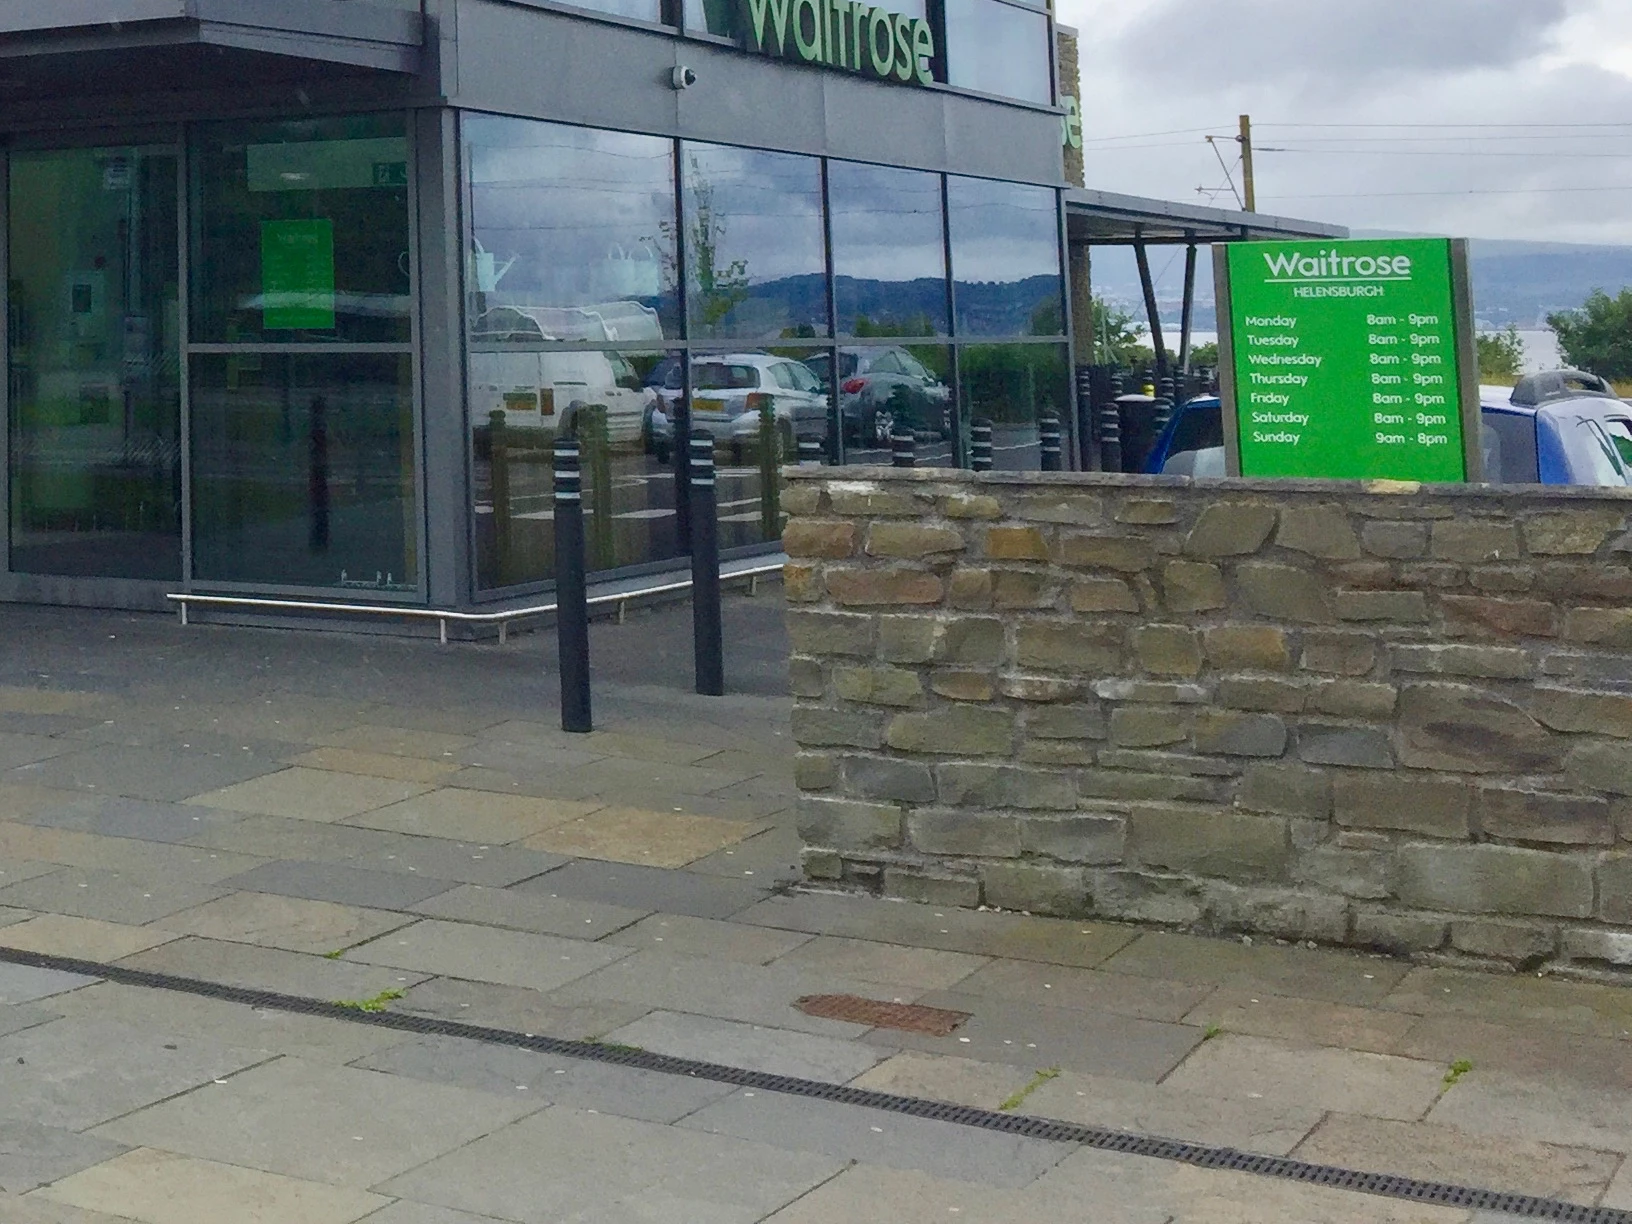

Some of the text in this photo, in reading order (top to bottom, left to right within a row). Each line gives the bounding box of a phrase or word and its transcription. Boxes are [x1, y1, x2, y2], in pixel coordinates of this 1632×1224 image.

[1263, 249, 1412, 277] Waitrose
[1293, 285, 1385, 298] HELENSBURGH
[1245, 315, 1297, 328] Monday
[1367, 314, 1396, 326] 8am
[1408, 314, 1439, 328] 9pm
[1247, 334, 1299, 348] Tuesday
[1368, 334, 1398, 345] 8am
[1410, 334, 1440, 347] 9pm
[1248, 353, 1322, 368] Wednesday
[1369, 353, 1400, 365] 8am
[1411, 353, 1442, 367] 9pm
[1249, 373, 1308, 387] Thursday
[1371, 373, 1401, 385] 8am
[1413, 373, 1443, 387] 9pm
[1250, 392, 1290, 406] Friday
[1372, 393, 1402, 404] 8am
[1414, 393, 1445, 407] 9pm
[1251, 412, 1310, 426] Saturday
[1374, 413, 1404, 424] 8am
[1416, 413, 1447, 427] 9pm
[1253, 431, 1301, 446] Sunday
[1375, 432, 1405, 444] 9am
[1417, 432, 1448, 446] 8pm
